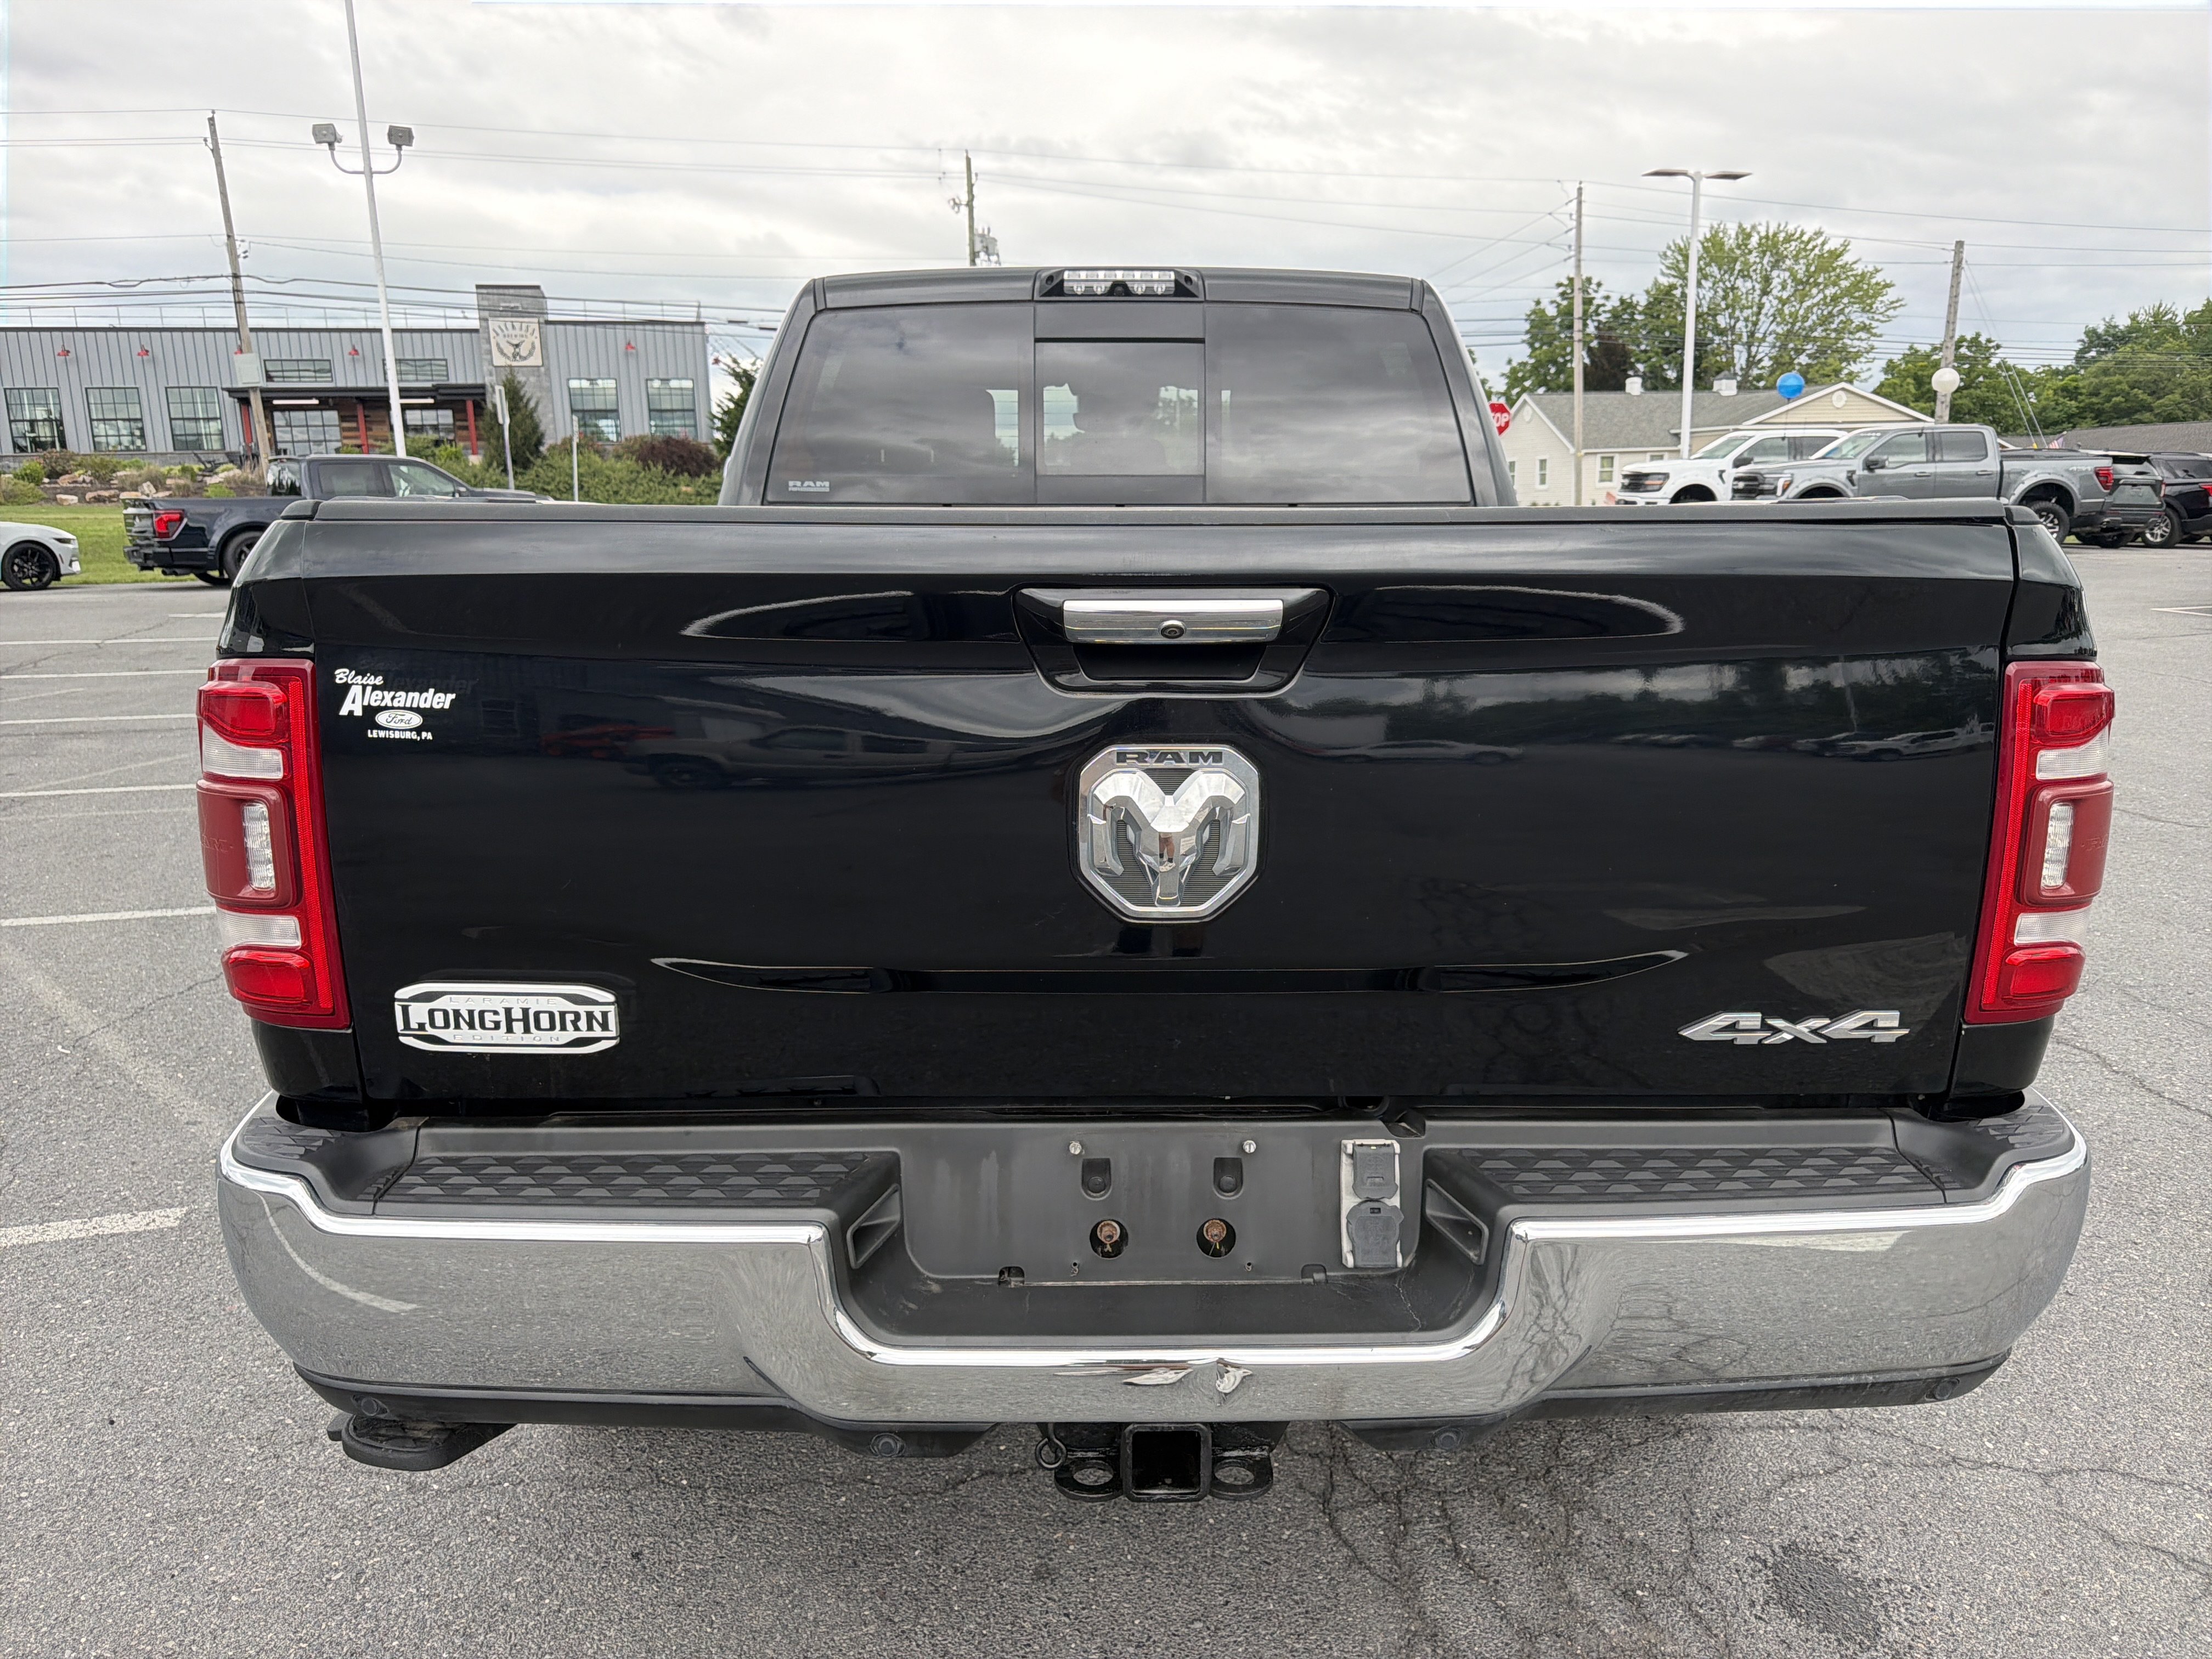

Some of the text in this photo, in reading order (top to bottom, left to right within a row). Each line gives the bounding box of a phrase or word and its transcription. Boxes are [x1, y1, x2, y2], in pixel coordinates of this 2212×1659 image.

[1492, 412, 1509, 427] OP
[334, 668, 384, 685] Blaise
[339, 685, 456, 716] Alexander
[386, 713, 413, 725] Ford
[368, 729, 433, 741] LEWISBURG, PA
[1116, 751, 1223, 766] RAM
[449, 996, 557, 1005] LARAMIE
